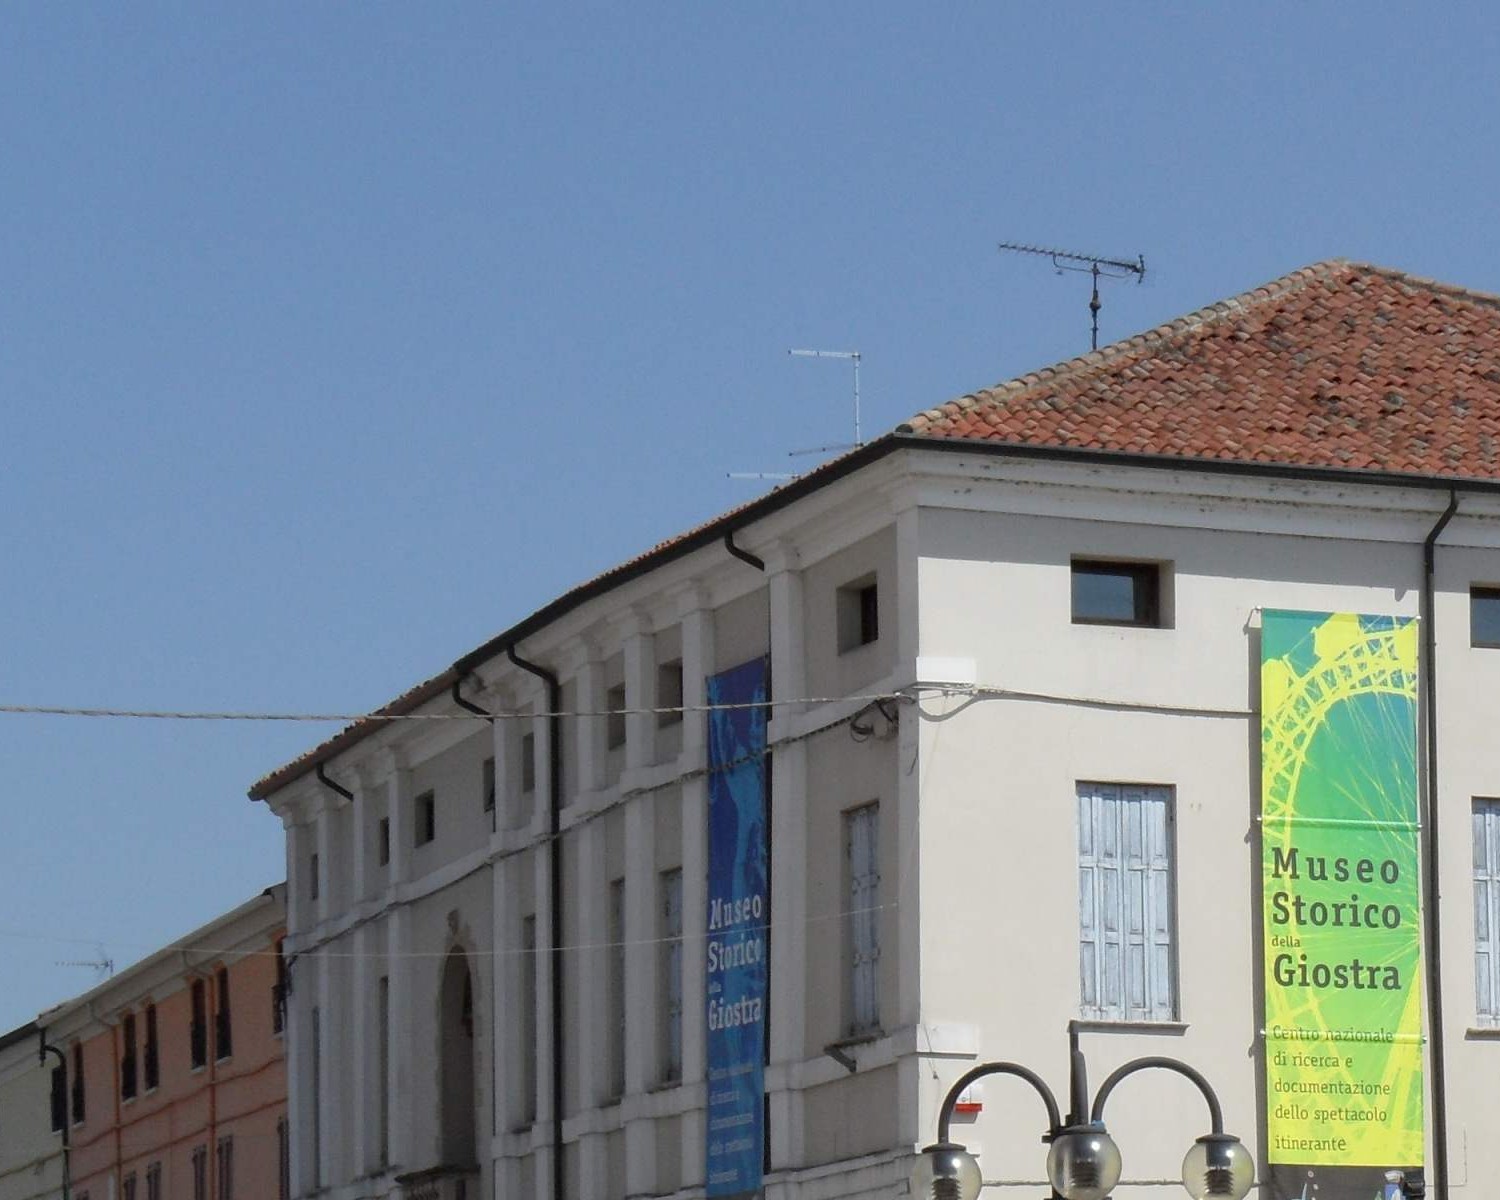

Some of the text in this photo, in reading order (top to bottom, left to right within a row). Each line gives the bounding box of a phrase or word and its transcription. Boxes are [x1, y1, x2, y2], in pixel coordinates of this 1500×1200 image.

[1271, 847, 1399, 884] Museo
[709, 894, 762, 930] Museo
[1272, 891, 1401, 929] Storico
[708, 933, 762, 973] Storico
[1271, 935, 1301, 948] della
[1273, 953, 1402, 990] Giostra
[708, 995, 762, 1031] Giostra
[1272, 1025, 1394, 1043] Centro nazionale
[1273, 1051, 1353, 1068] di ricerca e
[1274, 1078, 1391, 1096] documentazione
[1275, 1104, 1388, 1124] dello spettacolo
[1275, 1135, 1347, 1151] itinerante
